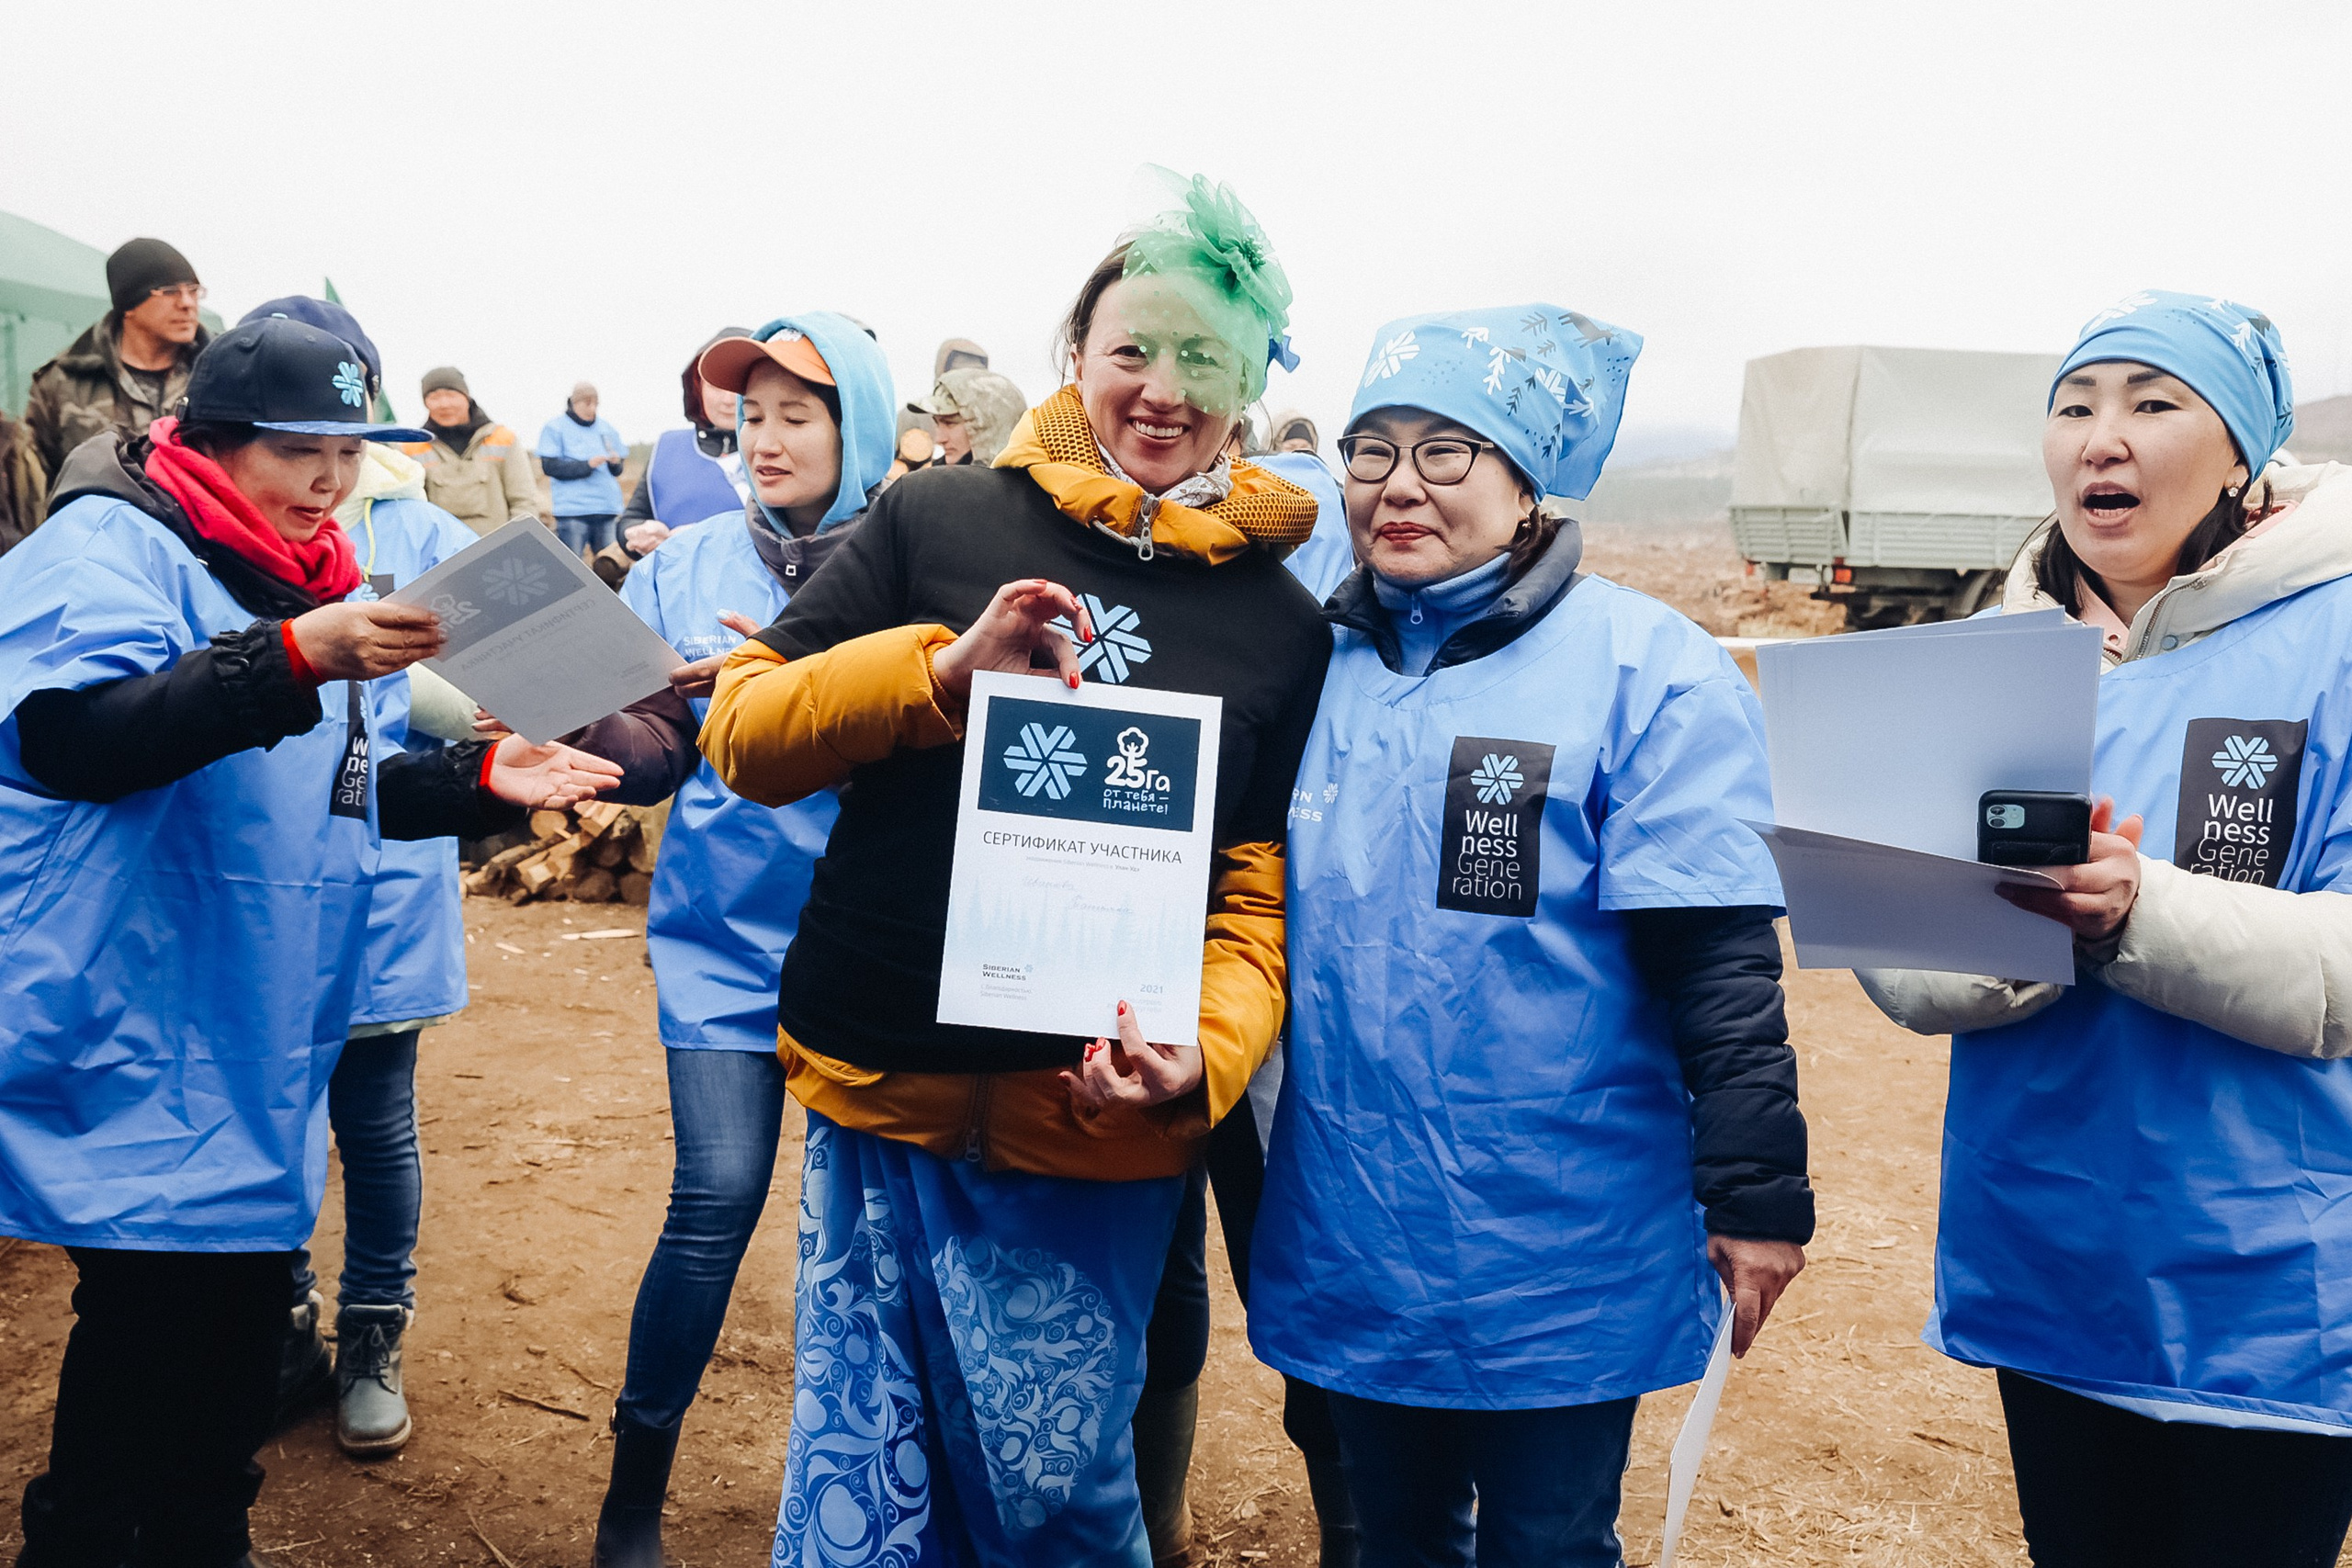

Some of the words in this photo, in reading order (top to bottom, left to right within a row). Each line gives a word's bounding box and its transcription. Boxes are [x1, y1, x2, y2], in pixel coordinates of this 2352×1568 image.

[684, 635, 737, 647] SIBERIAN
[684, 646, 733, 658] WELLNE
[346, 757, 368, 773] ne
[342, 769, 367, 790] Ge
[1103, 788, 1121, 797] от
[1125, 789, 1156, 802] тебя
[2208, 794, 2274, 823] Well
[1465, 809, 1518, 837] Well
[2204, 820, 2270, 845] ness
[982, 830, 1086, 854] СЕРТИФИКАТ
[1090, 841, 1182, 864] УЧАСТНИКА
[1462, 836, 1518, 857] ness
[2198, 837, 2269, 866] Gene
[1457, 851, 1521, 879] Gene
[1453, 874, 1522, 900] ration
[982, 964, 1021, 973] SIBERIAN
[982, 971, 1027, 981] WELLNESS
[1140, 984, 1163, 994] 2021
